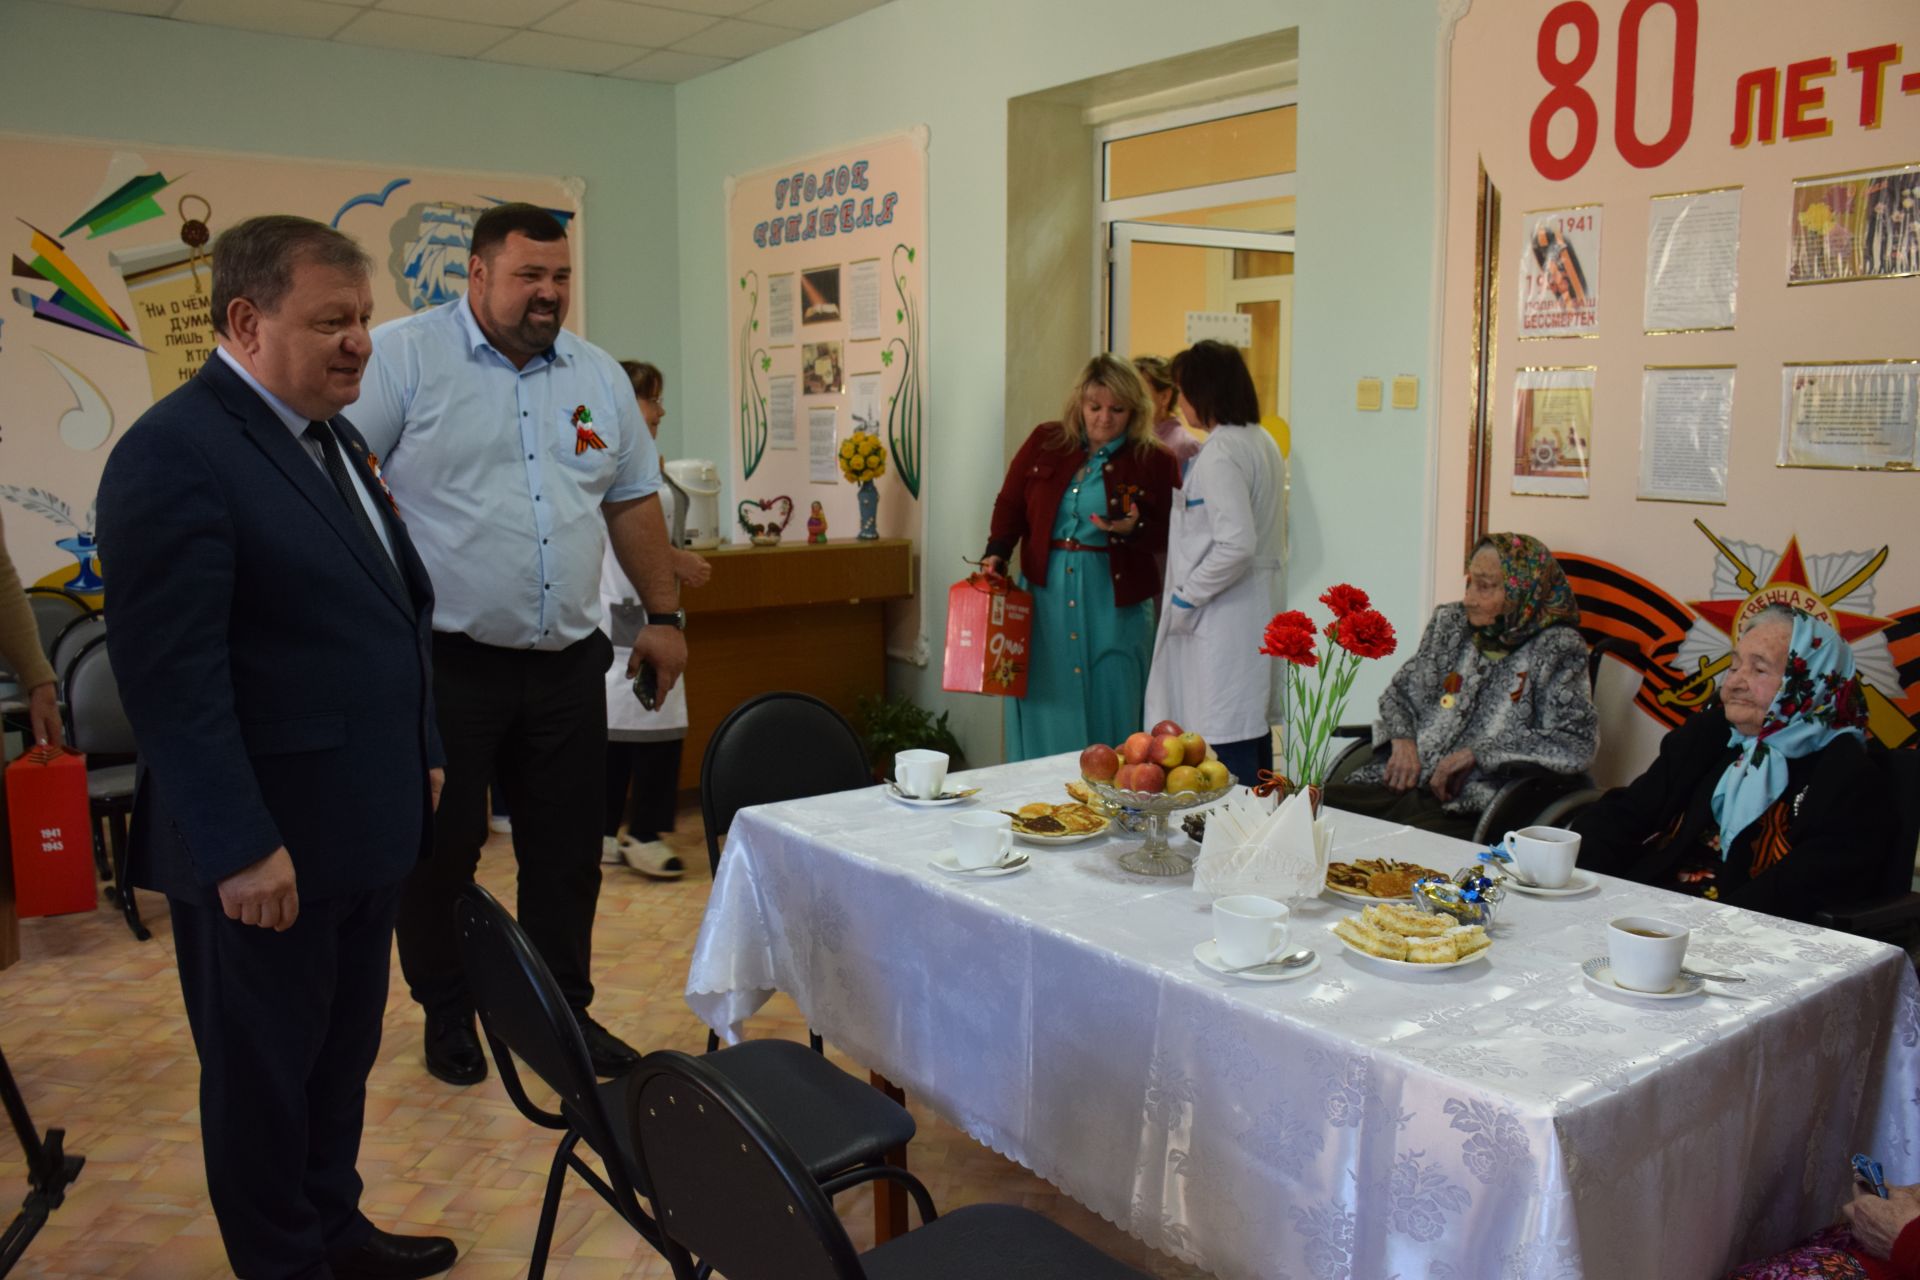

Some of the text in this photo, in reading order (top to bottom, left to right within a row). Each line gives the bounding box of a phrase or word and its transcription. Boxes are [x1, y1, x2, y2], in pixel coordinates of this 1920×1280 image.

[1529, 0, 1699, 181] 80
[775, 160, 869, 210] УГОЛОК
[753, 192, 898, 248] ЧИТАТЕЛЯ
[1558, 216, 1593, 233] 1941
[170, 313, 213, 333] ДУМА
[165, 332, 204, 347] ЛИШЬ
[41, 828, 61, 839] 1941
